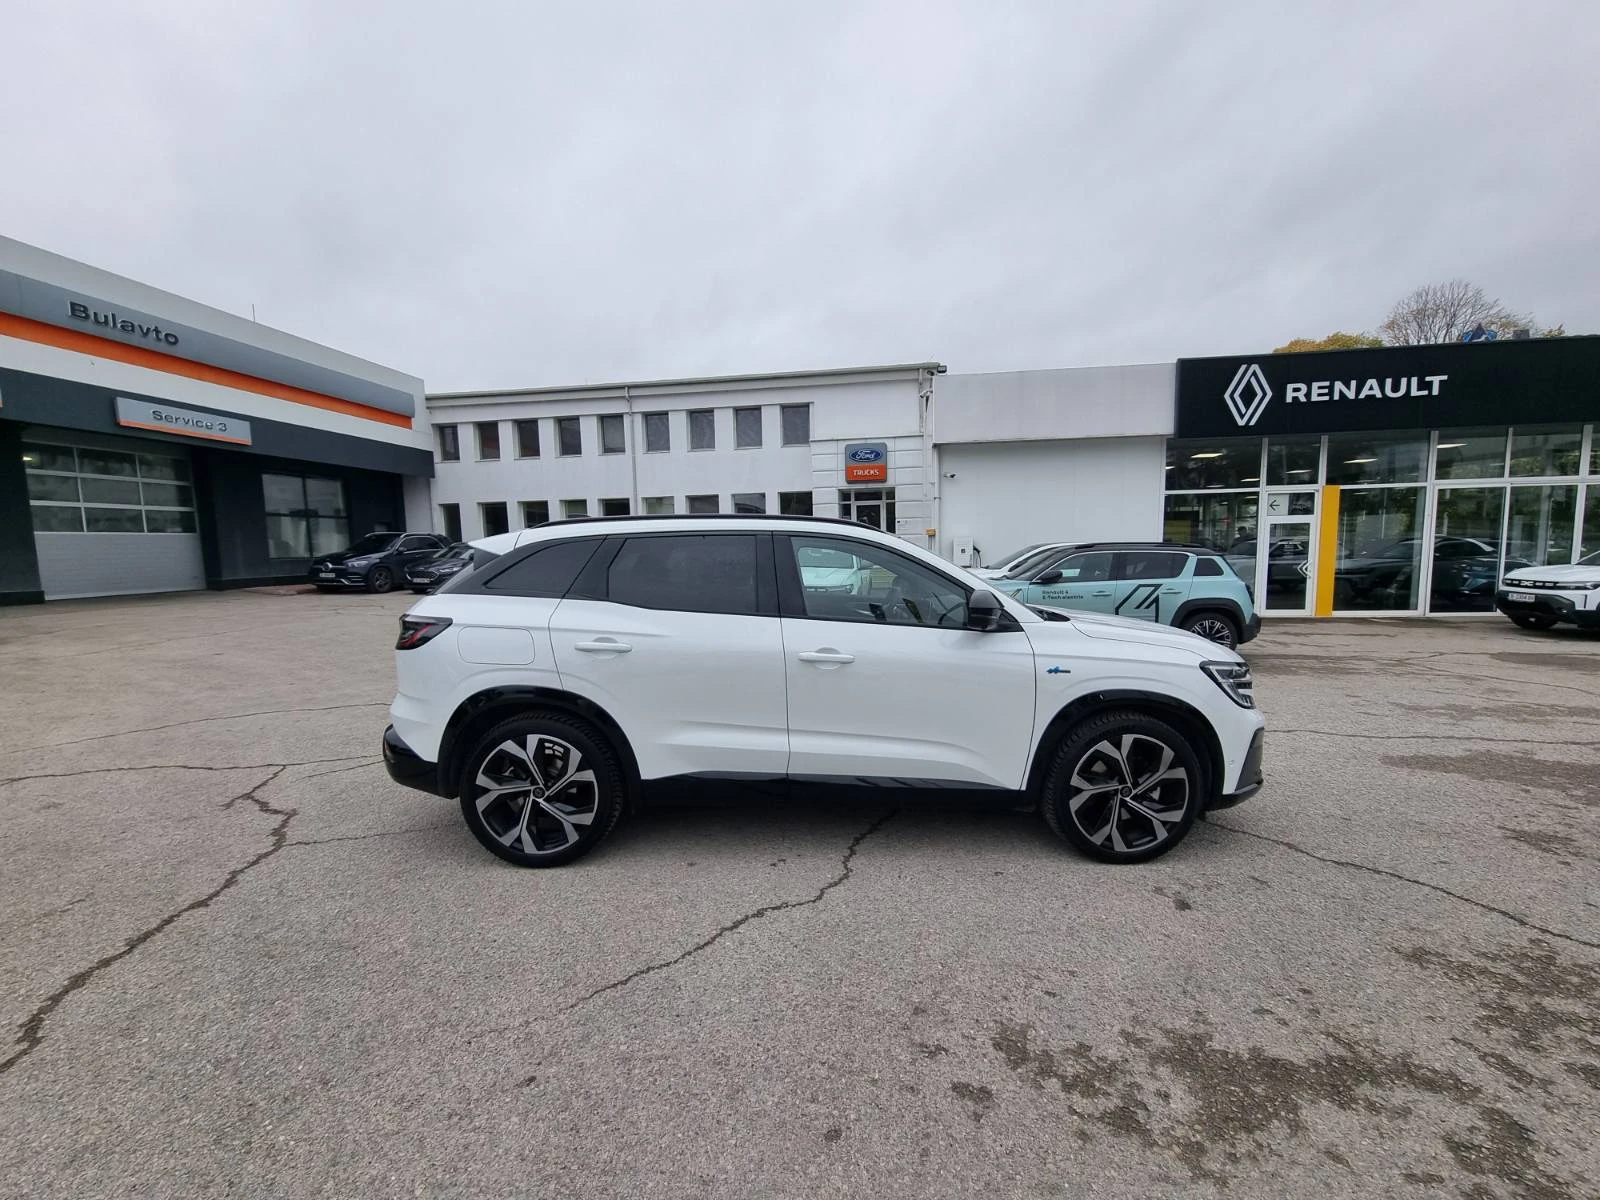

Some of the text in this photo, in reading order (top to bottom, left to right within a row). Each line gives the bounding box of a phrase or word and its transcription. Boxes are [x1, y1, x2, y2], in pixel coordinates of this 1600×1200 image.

[68, 300, 179, 346] Bulavto
[1285, 374, 1449, 403] RENAULT
[151, 410, 228, 432] Service 3
[855, 450, 876, 459] Ford
